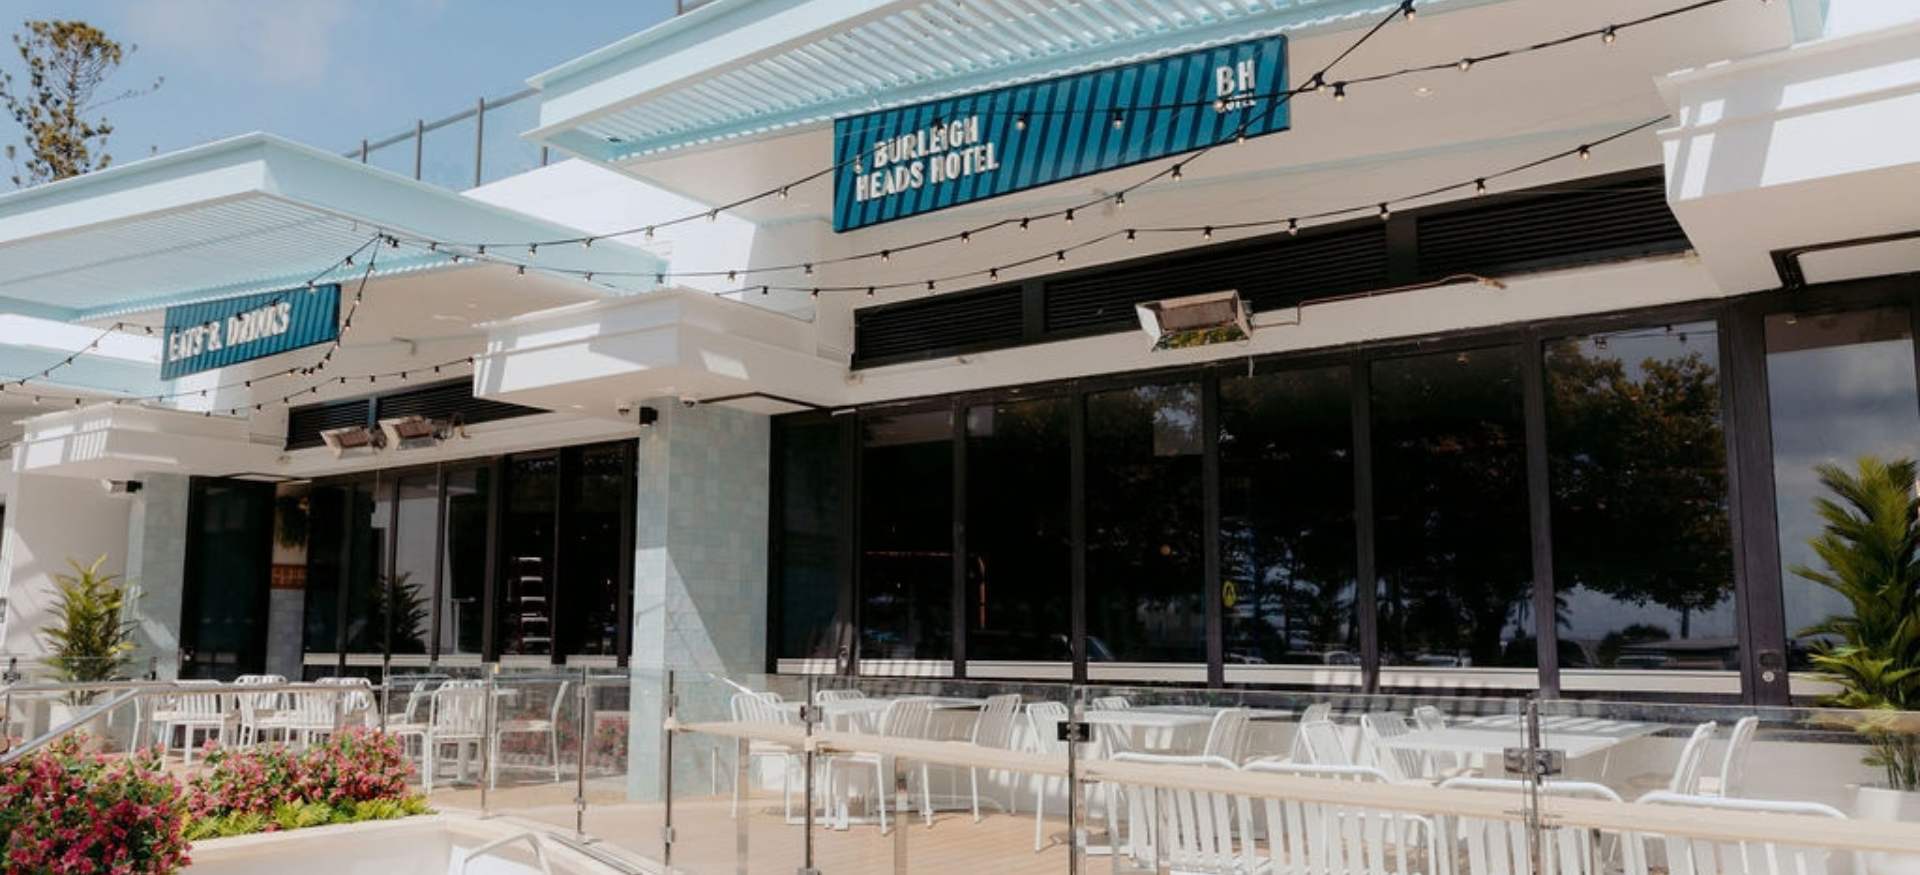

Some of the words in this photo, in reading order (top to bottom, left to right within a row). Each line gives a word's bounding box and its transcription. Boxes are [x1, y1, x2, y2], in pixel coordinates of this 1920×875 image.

[1216, 59, 1255, 97] BH
[1217, 92, 1256, 112] OTEL
[874, 116, 979, 169] BURLEIGH
[856, 161, 924, 202] HEADS
[931, 142, 1000, 184] HOTEL
[169, 326, 203, 361] EATS
[208, 321, 222, 351] &
[226, 302, 290, 346] DRINKS
